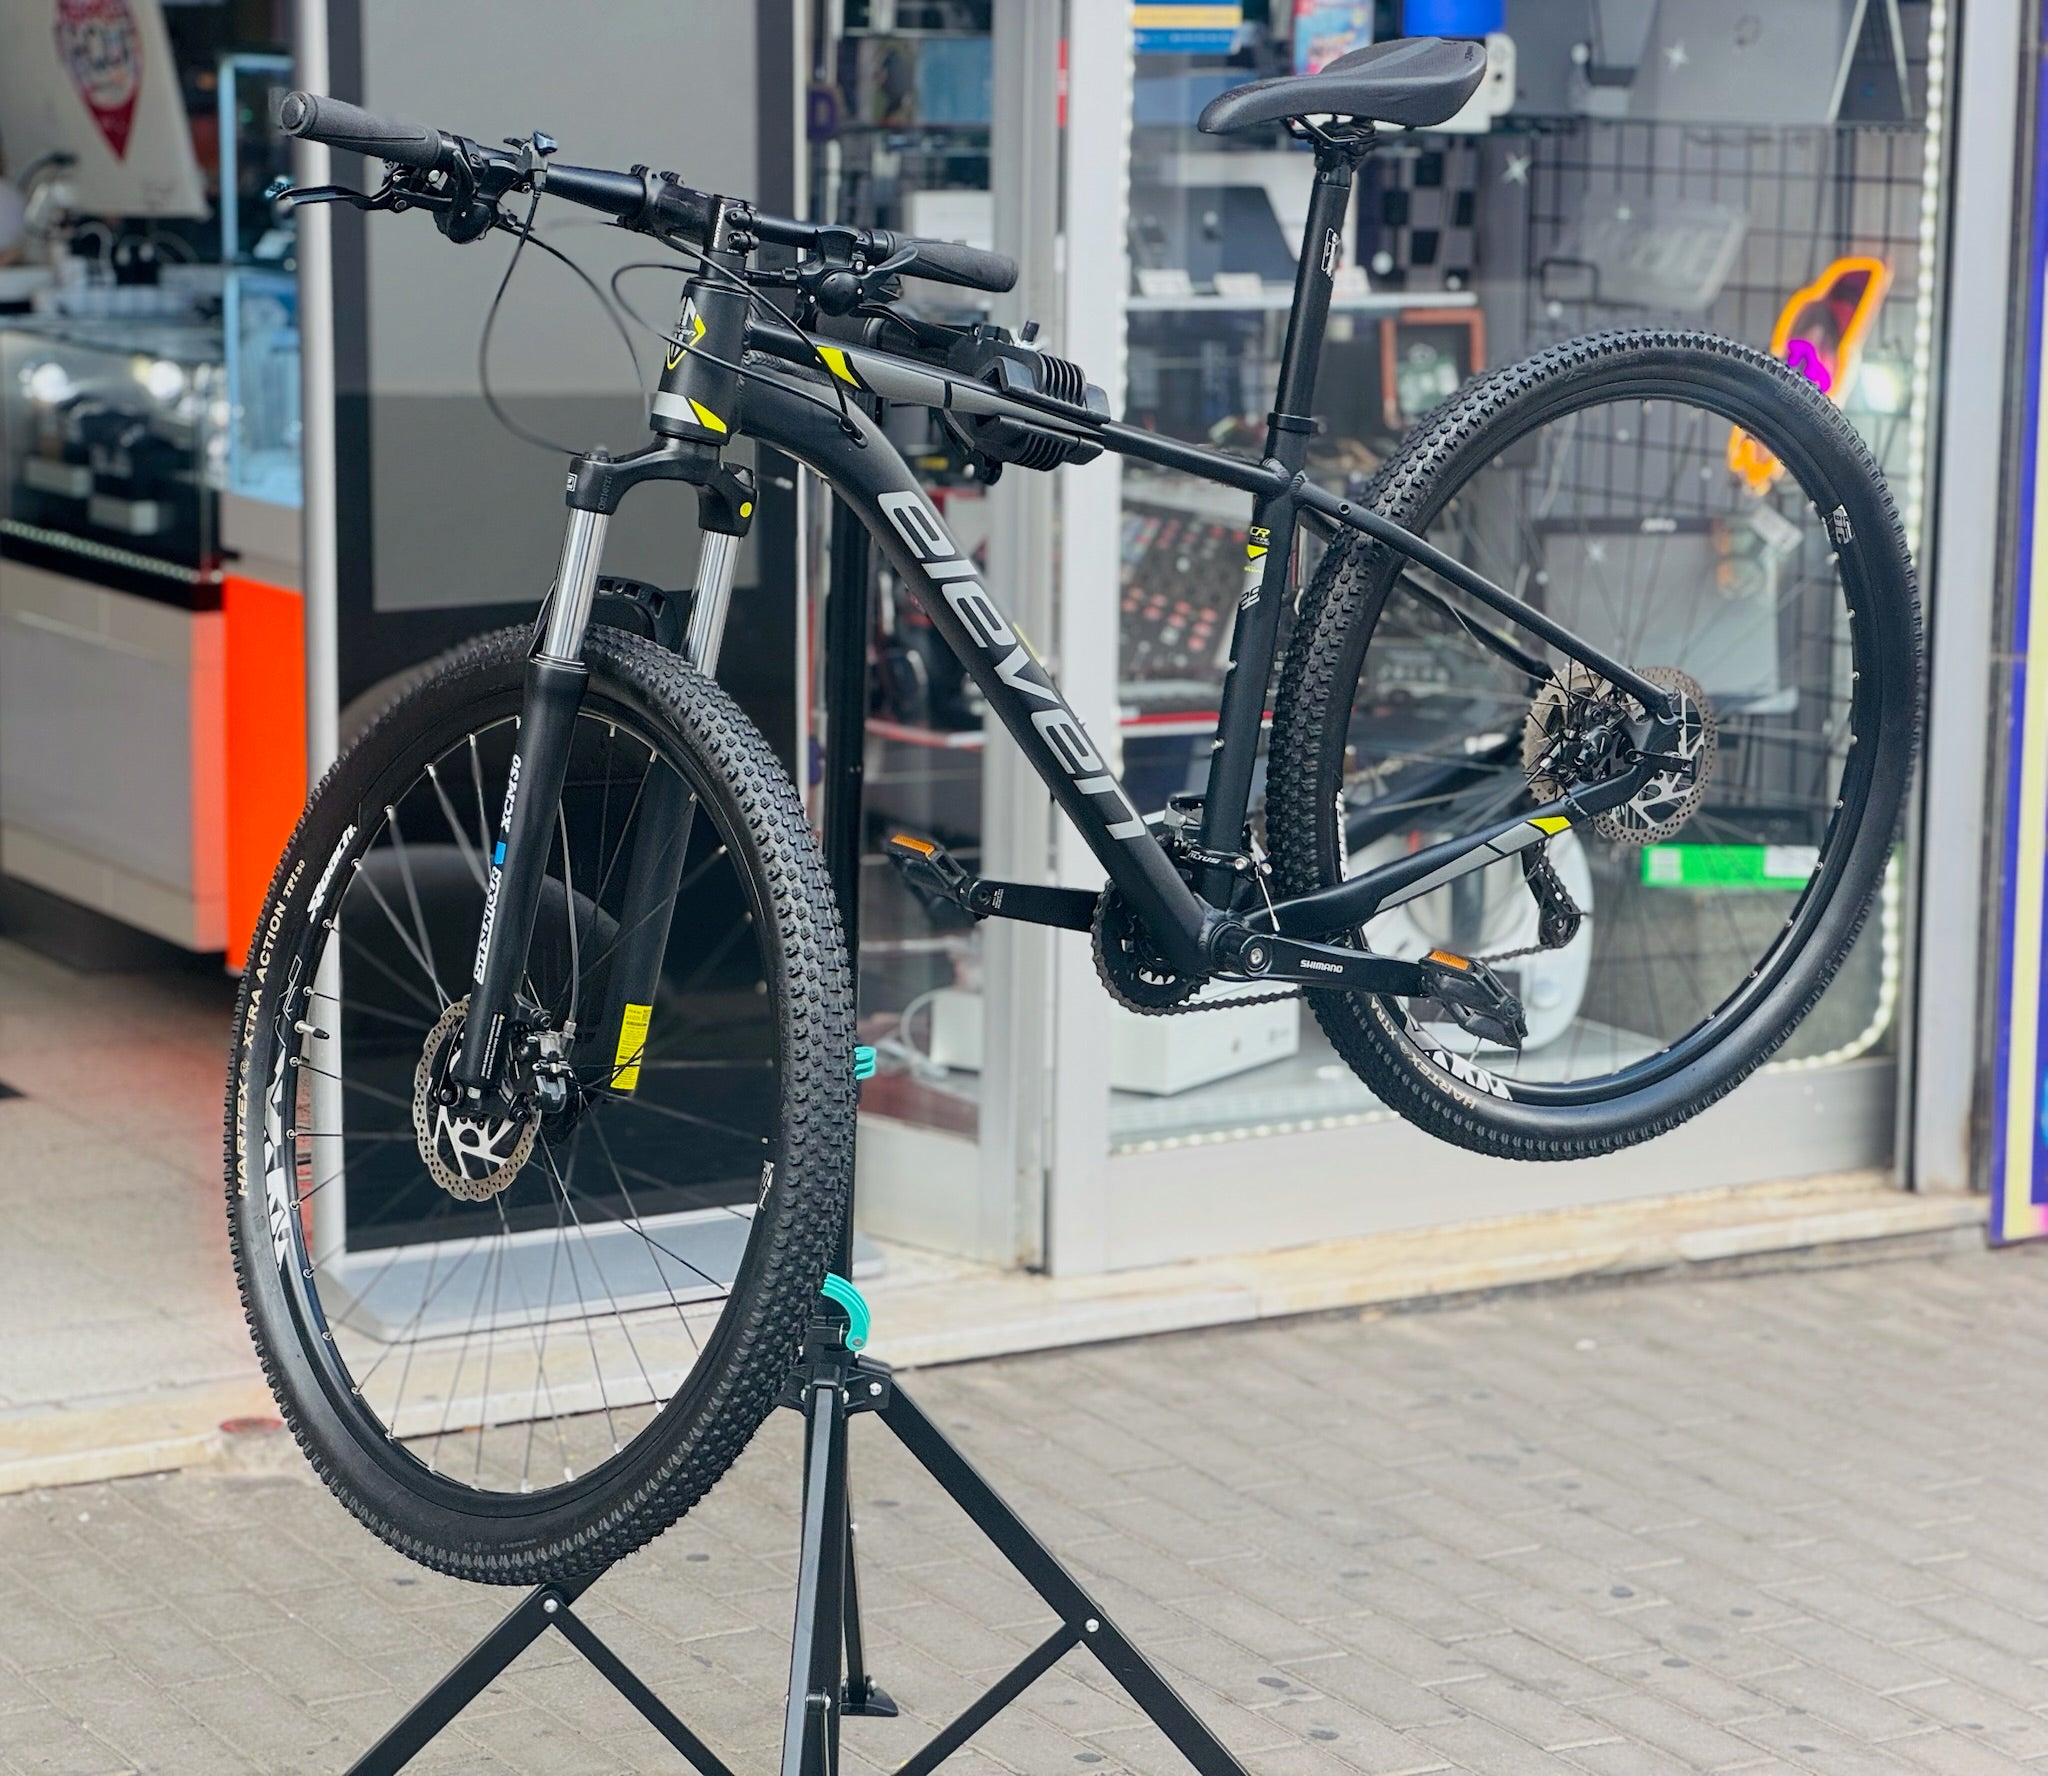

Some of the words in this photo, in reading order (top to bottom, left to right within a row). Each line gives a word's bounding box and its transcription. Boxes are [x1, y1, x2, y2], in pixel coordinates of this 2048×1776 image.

[878, 490, 1146, 840] eleven
[501, 753, 522, 834] XCM30
[254, 900, 288, 984] ACTION
[1300, 958, 1344, 974] SHIMANO
[241, 988, 264, 1050] XTRA
[1370, 995, 1398, 1041] XTRA
[1407, 1052, 1477, 1111] HARTEX
[235, 1078, 251, 1197] HARTEX
